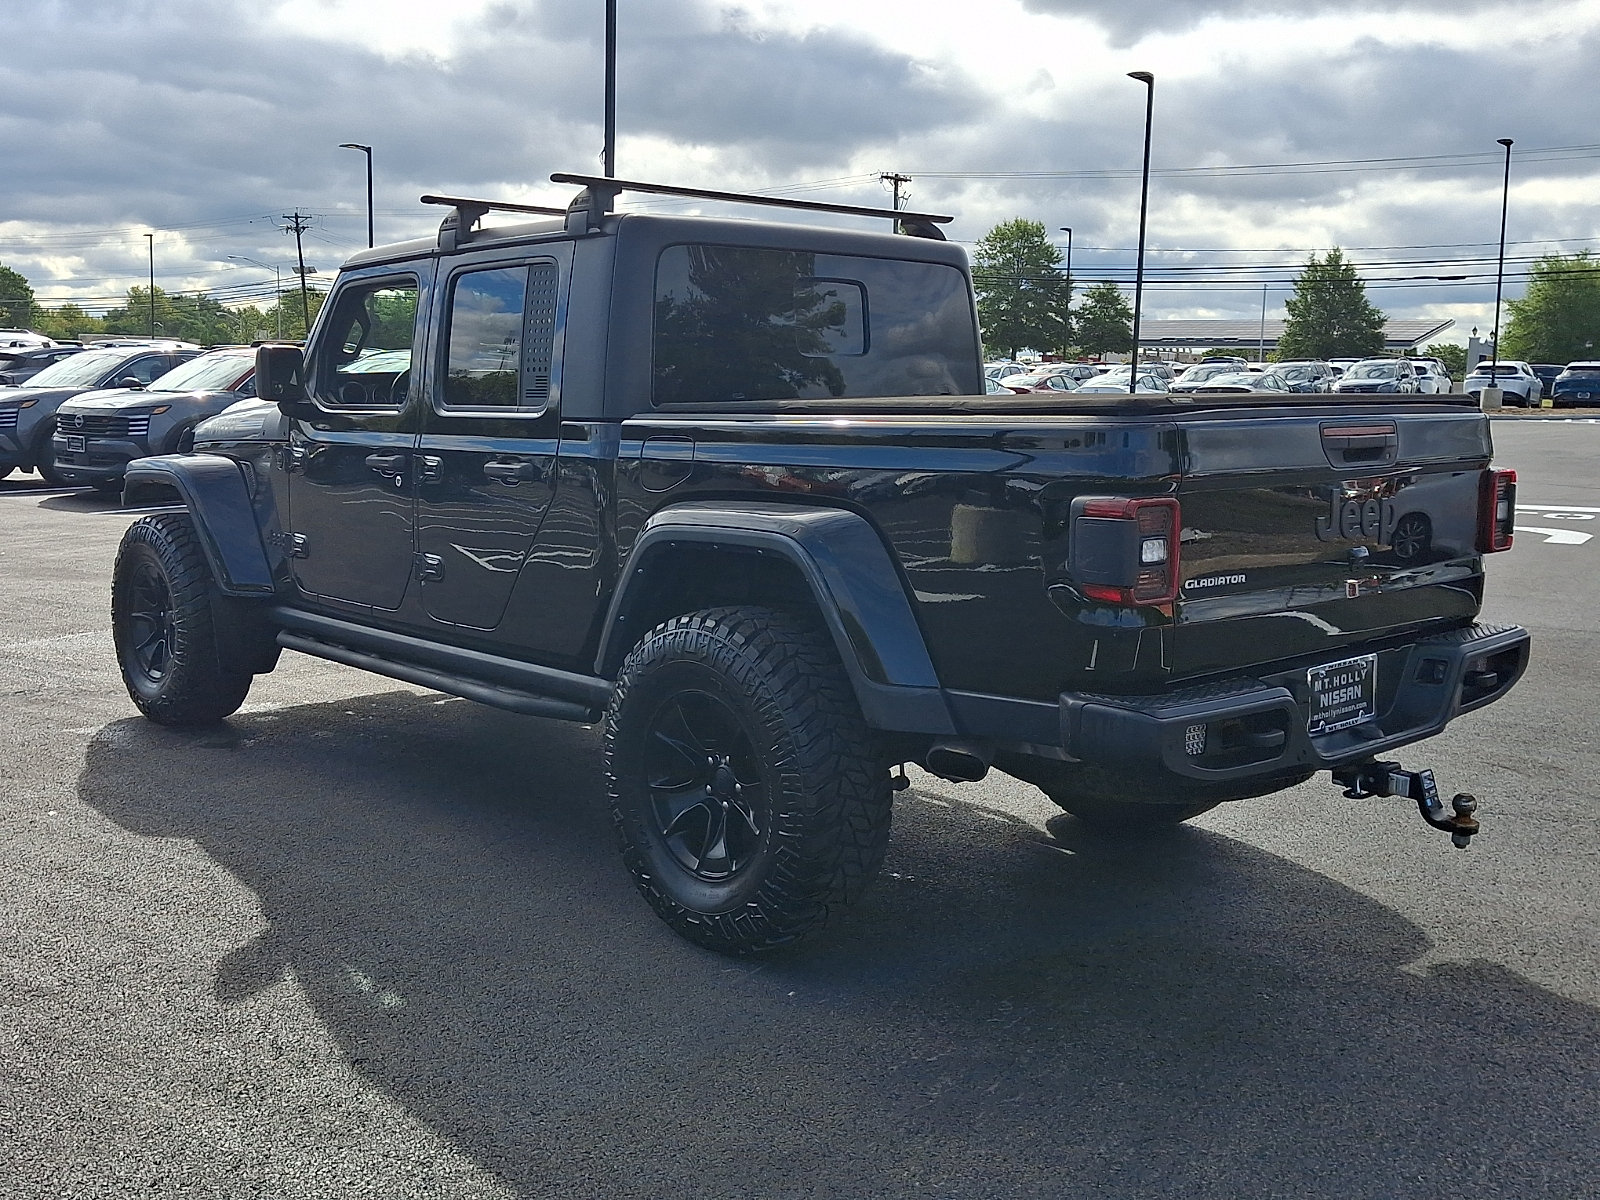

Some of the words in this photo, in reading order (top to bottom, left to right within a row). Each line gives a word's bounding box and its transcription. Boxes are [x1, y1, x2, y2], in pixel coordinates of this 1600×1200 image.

[1315, 488, 1396, 546] Jeep
[1184, 574, 1247, 589] GLADIATOR
[1314, 678, 1332, 692] MT.
[1333, 669, 1368, 687] HOLLY
[1320, 685, 1362, 708] NISSAN
